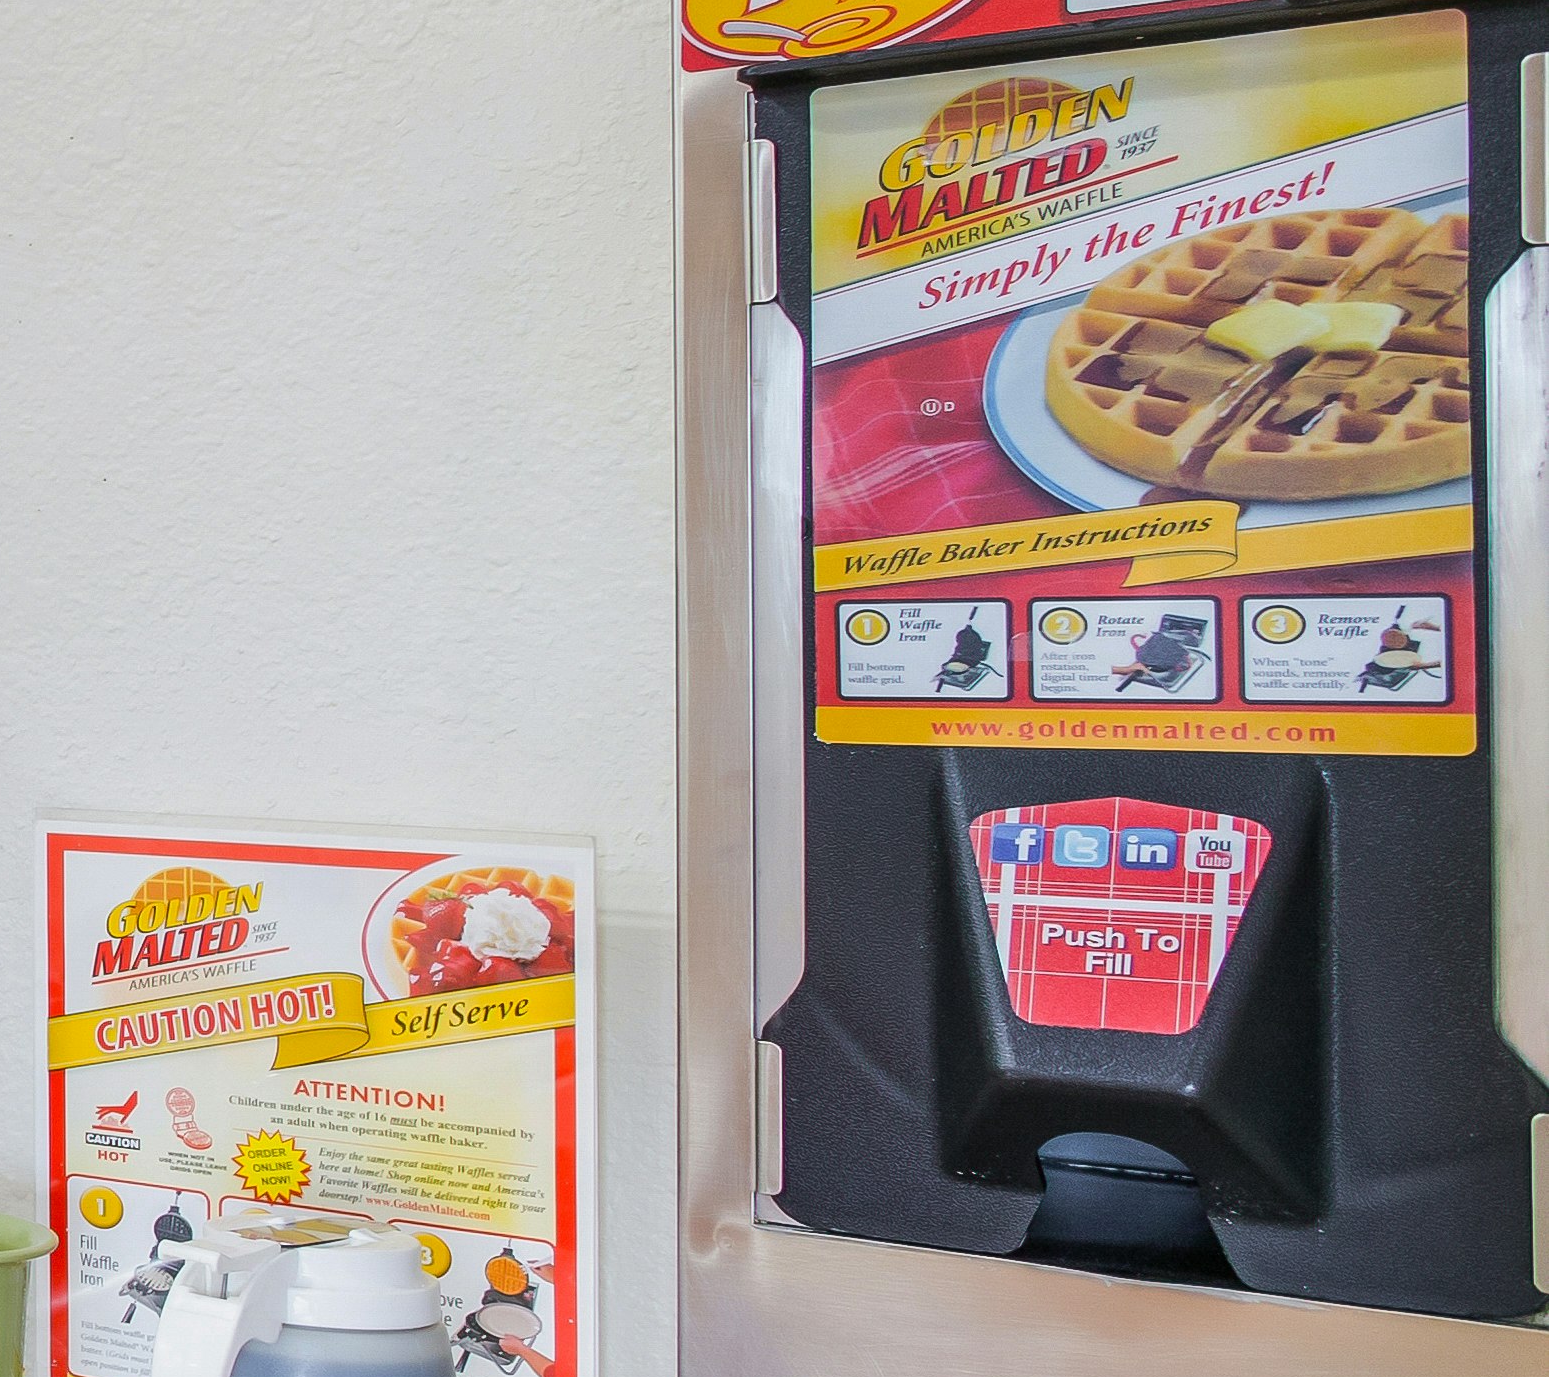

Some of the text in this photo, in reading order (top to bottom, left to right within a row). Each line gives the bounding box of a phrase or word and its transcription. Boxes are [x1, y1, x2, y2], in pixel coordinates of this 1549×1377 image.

[879, 76, 1135, 192] GOLDEN
[1116, 124, 1160, 148] SINCE
[1120, 139, 1157, 161] 1937
[857, 137, 1108, 250] MALTED
[921, 181, 1123, 258] AMERICA'S WAFFLE
[918, 160, 1335, 310] Simply the Finest!
[844, 516, 1213, 576] Waffle Baker Instructions
[899, 608, 922, 618] Fill
[1098, 615, 1145, 625] Rotate
[1318, 614, 1380, 624] Remove
[899, 620, 942, 631] Waffle
[1096, 627, 1126, 637] Iron
[1269, 615, 1286, 634] 3
[1318, 626, 1369, 639] Waffle
[899, 632, 926, 642] Iron
[1040, 652, 1096, 661] After iron
[1253, 658, 1289, 666] When
[848, 663, 905, 672] Fill bottom
[1304, 670, 1350, 678] remove
[848, 675, 905, 686] waffle grid.
[1041, 673, 1110, 683] digital timer
[1253, 680, 1350, 691] waffle carefully.
[1041, 683, 1080, 693] begins.
[931, 720, 1336, 742] www.goldenmalted.com
[1199, 836, 1231, 852] You
[1198, 852, 1231, 869] Tube
[107, 881, 264, 938] GOLDEN
[252, 921, 278, 934] SINCE
[254, 931, 277, 943] 1937
[1041, 923, 1181, 953] Push To
[92, 917, 250, 977] MALTED
[1085, 952, 1133, 976] Fill
[129, 959, 257, 991] AMERICA'S WAFFLE
[96, 983, 335, 1052] CAUTION HOT!
[391, 995, 529, 1039] Self Serve
[293, 1079, 445, 1112] ATTENTION!
[229, 1095, 535, 1142] Children under the age of 16 must be accompanied by
[86, 1133, 140, 1149] CAUTION
[287, 1117, 315, 1128] adult
[318, 1122, 349, 1132] when
[352, 1126, 407, 1141] operating
[411, 1133, 446, 1144] waffle
[449, 1136, 488, 1149] baker.
[98, 1149, 129, 1163] HOT
[248, 1148, 286, 1159] ORDER
[253, 1161, 293, 1172] ONLINE
[319, 1147, 347, 1161] Enjoy
[349, 1152, 364, 1161] the
[393, 1160, 418, 1169] great
[421, 1162, 454, 1174] tasting
[457, 1165, 494, 1178] Waffles
[498, 1173, 531, 1183] served
[261, 1176, 291, 1185] NOW!
[318, 1161, 339, 1172] here
[353, 1165, 384, 1178] home!
[386, 1170, 412, 1183] Shop
[414, 1175, 446, 1186] online
[448, 1180, 468, 1188] now
[472, 1183, 491, 1192] and
[494, 1184, 545, 1199] America's
[319, 1175, 547, 1213] Favorite Waffles will be delivered right to your
[96, 1198, 104, 1216] 1
[318, 1189, 490, 1221] doorstep! www.GoldenMalted.com
[80, 1234, 97, 1250] Fill
[80, 1252, 119, 1272] Waffle
[80, 1270, 104, 1287] Iron
